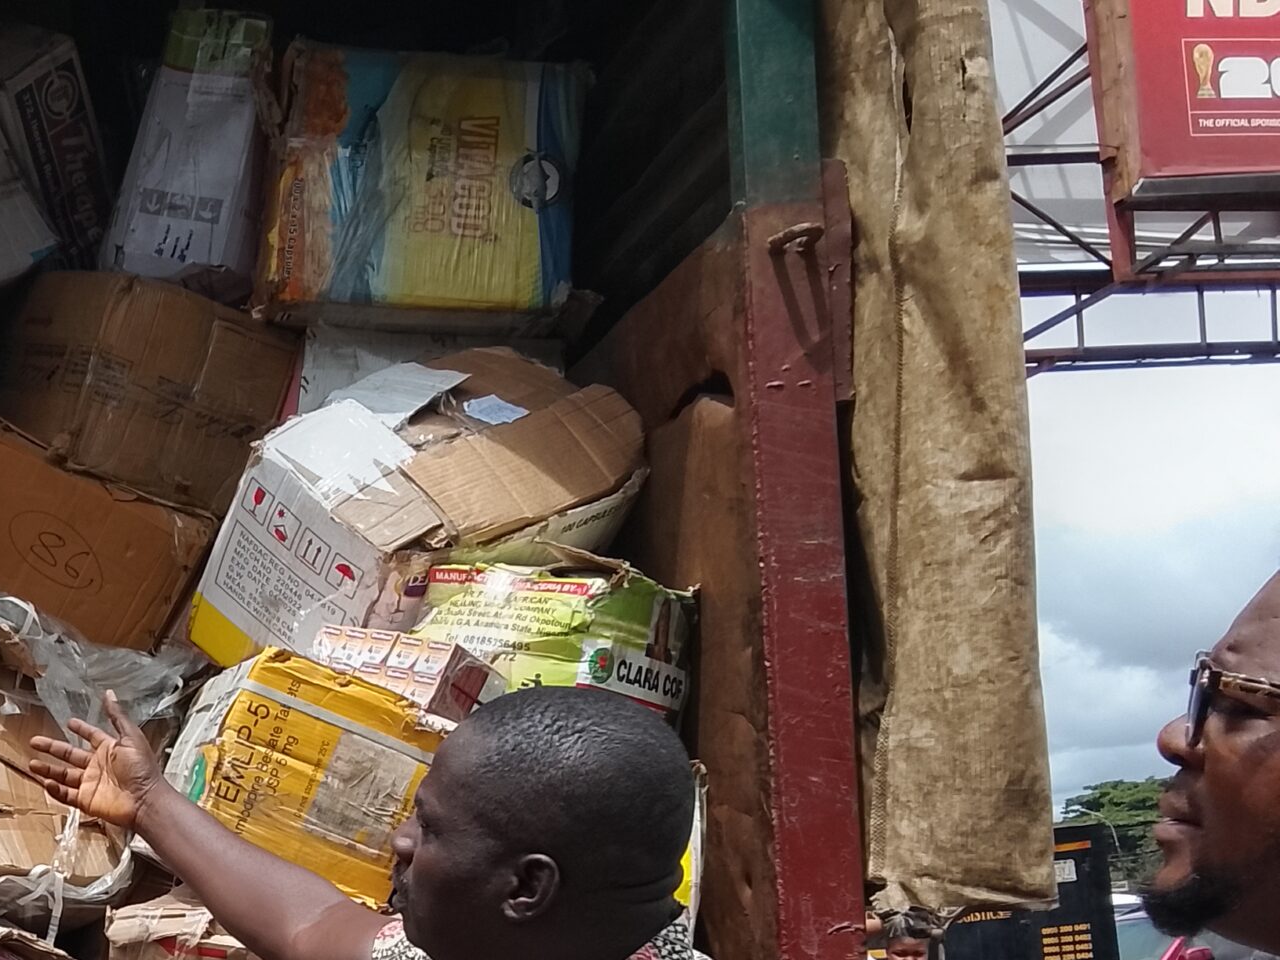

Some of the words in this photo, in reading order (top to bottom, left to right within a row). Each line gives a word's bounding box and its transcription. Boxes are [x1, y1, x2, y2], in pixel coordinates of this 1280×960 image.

[1218, 57, 1280, 98] 2
[1199, 119, 1215, 127] THE
[1215, 119, 1249, 127] OFFICIAL
[236, 539, 259, 564] BATCH
[239, 530, 270, 561] NAFDAC
[223, 580, 252, 609] HANDLE
[252, 605, 271, 625] WITH
[281, 619, 294, 634] CM
[616, 659, 660, 693] CLARA
[215, 699, 270, 803] EMLIP-5
[282, 735, 299, 755] mg
